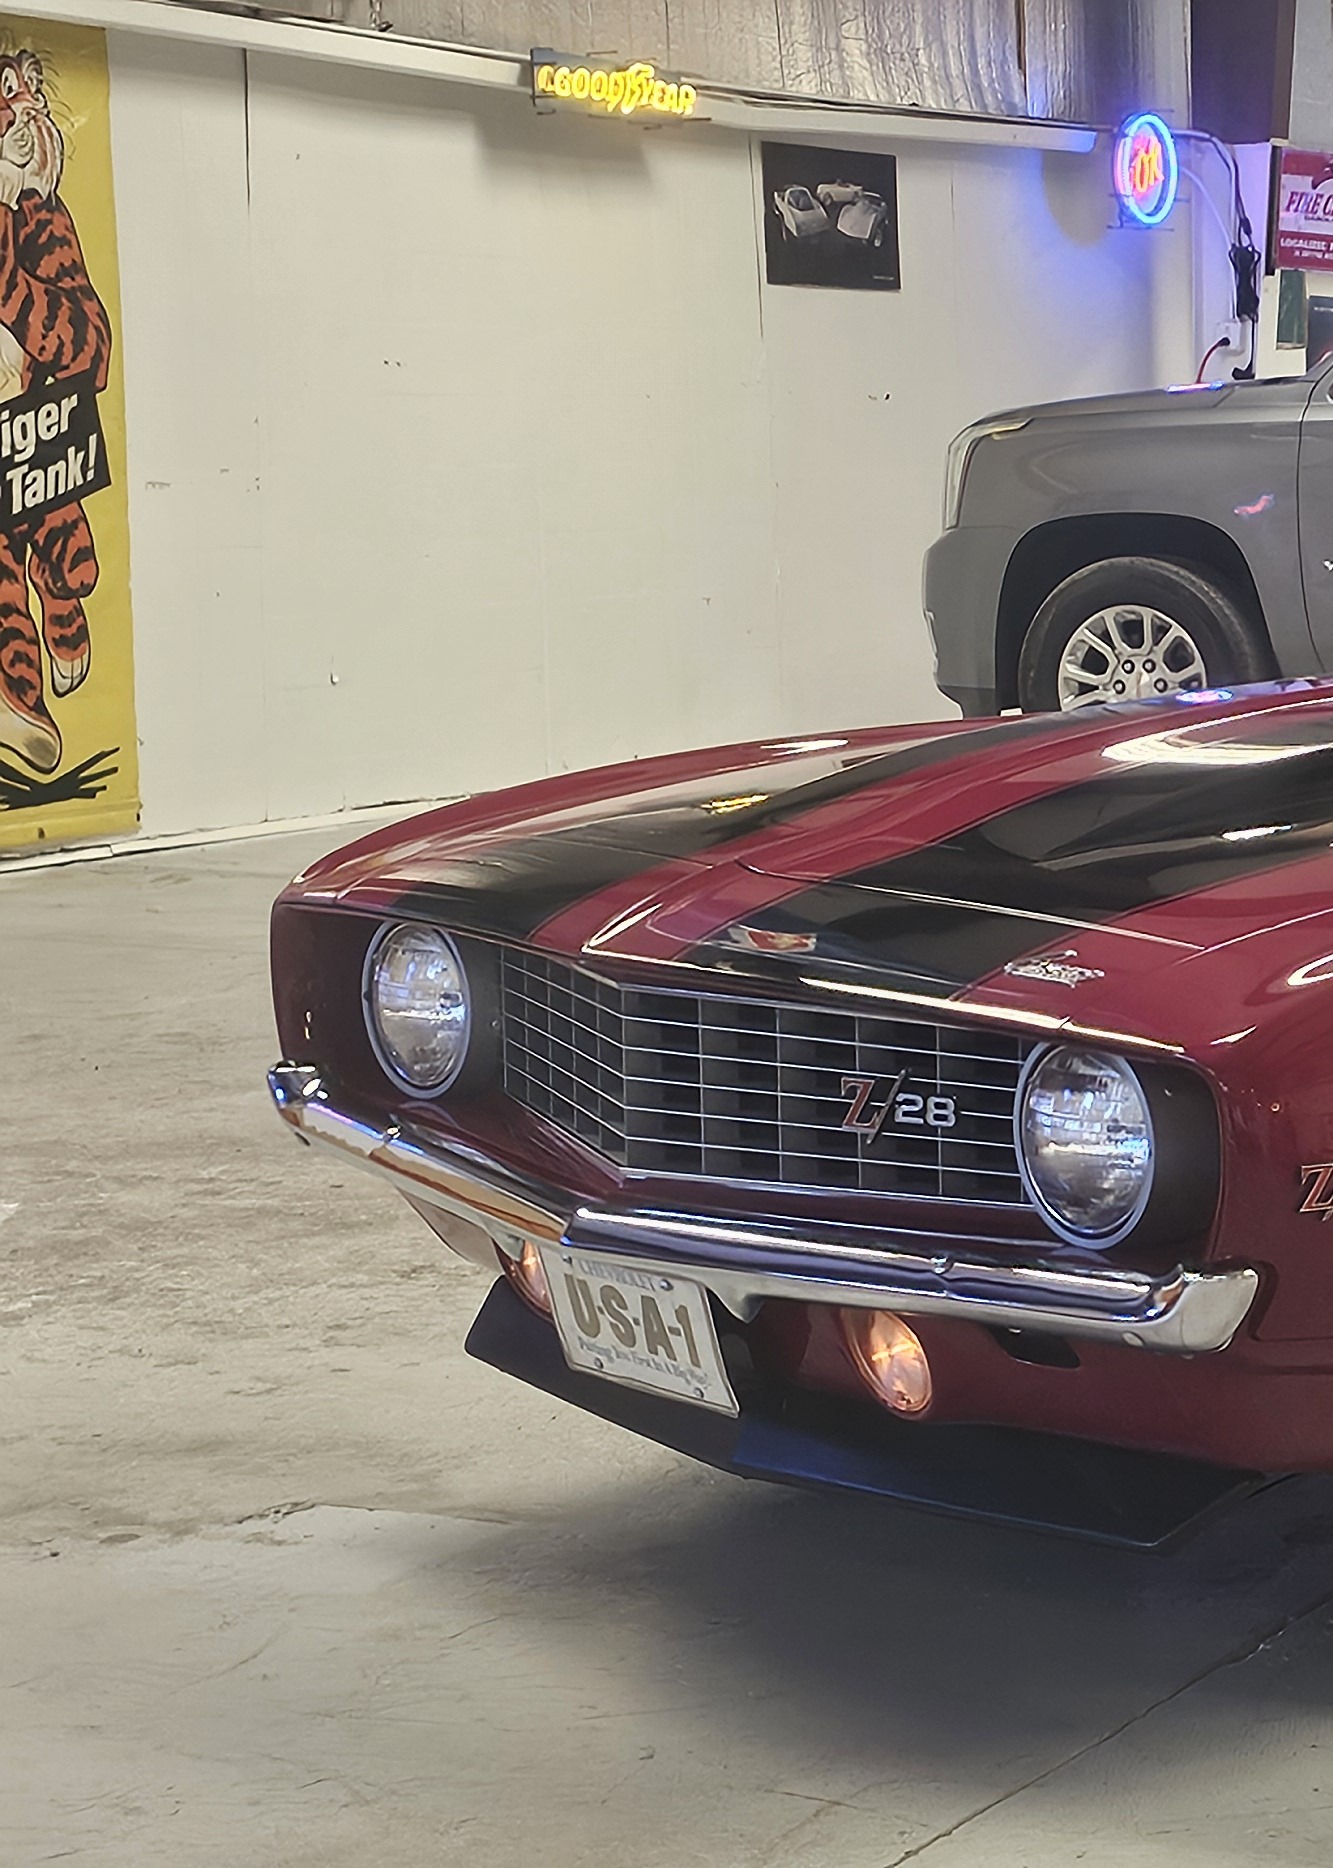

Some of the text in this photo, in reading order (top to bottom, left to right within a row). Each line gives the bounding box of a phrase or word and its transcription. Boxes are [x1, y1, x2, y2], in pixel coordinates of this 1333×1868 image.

[1285, 191, 1325, 214] FIRE
[6, 433, 97, 515] Tank!
[840, 1068, 957, 1145] Z/28
